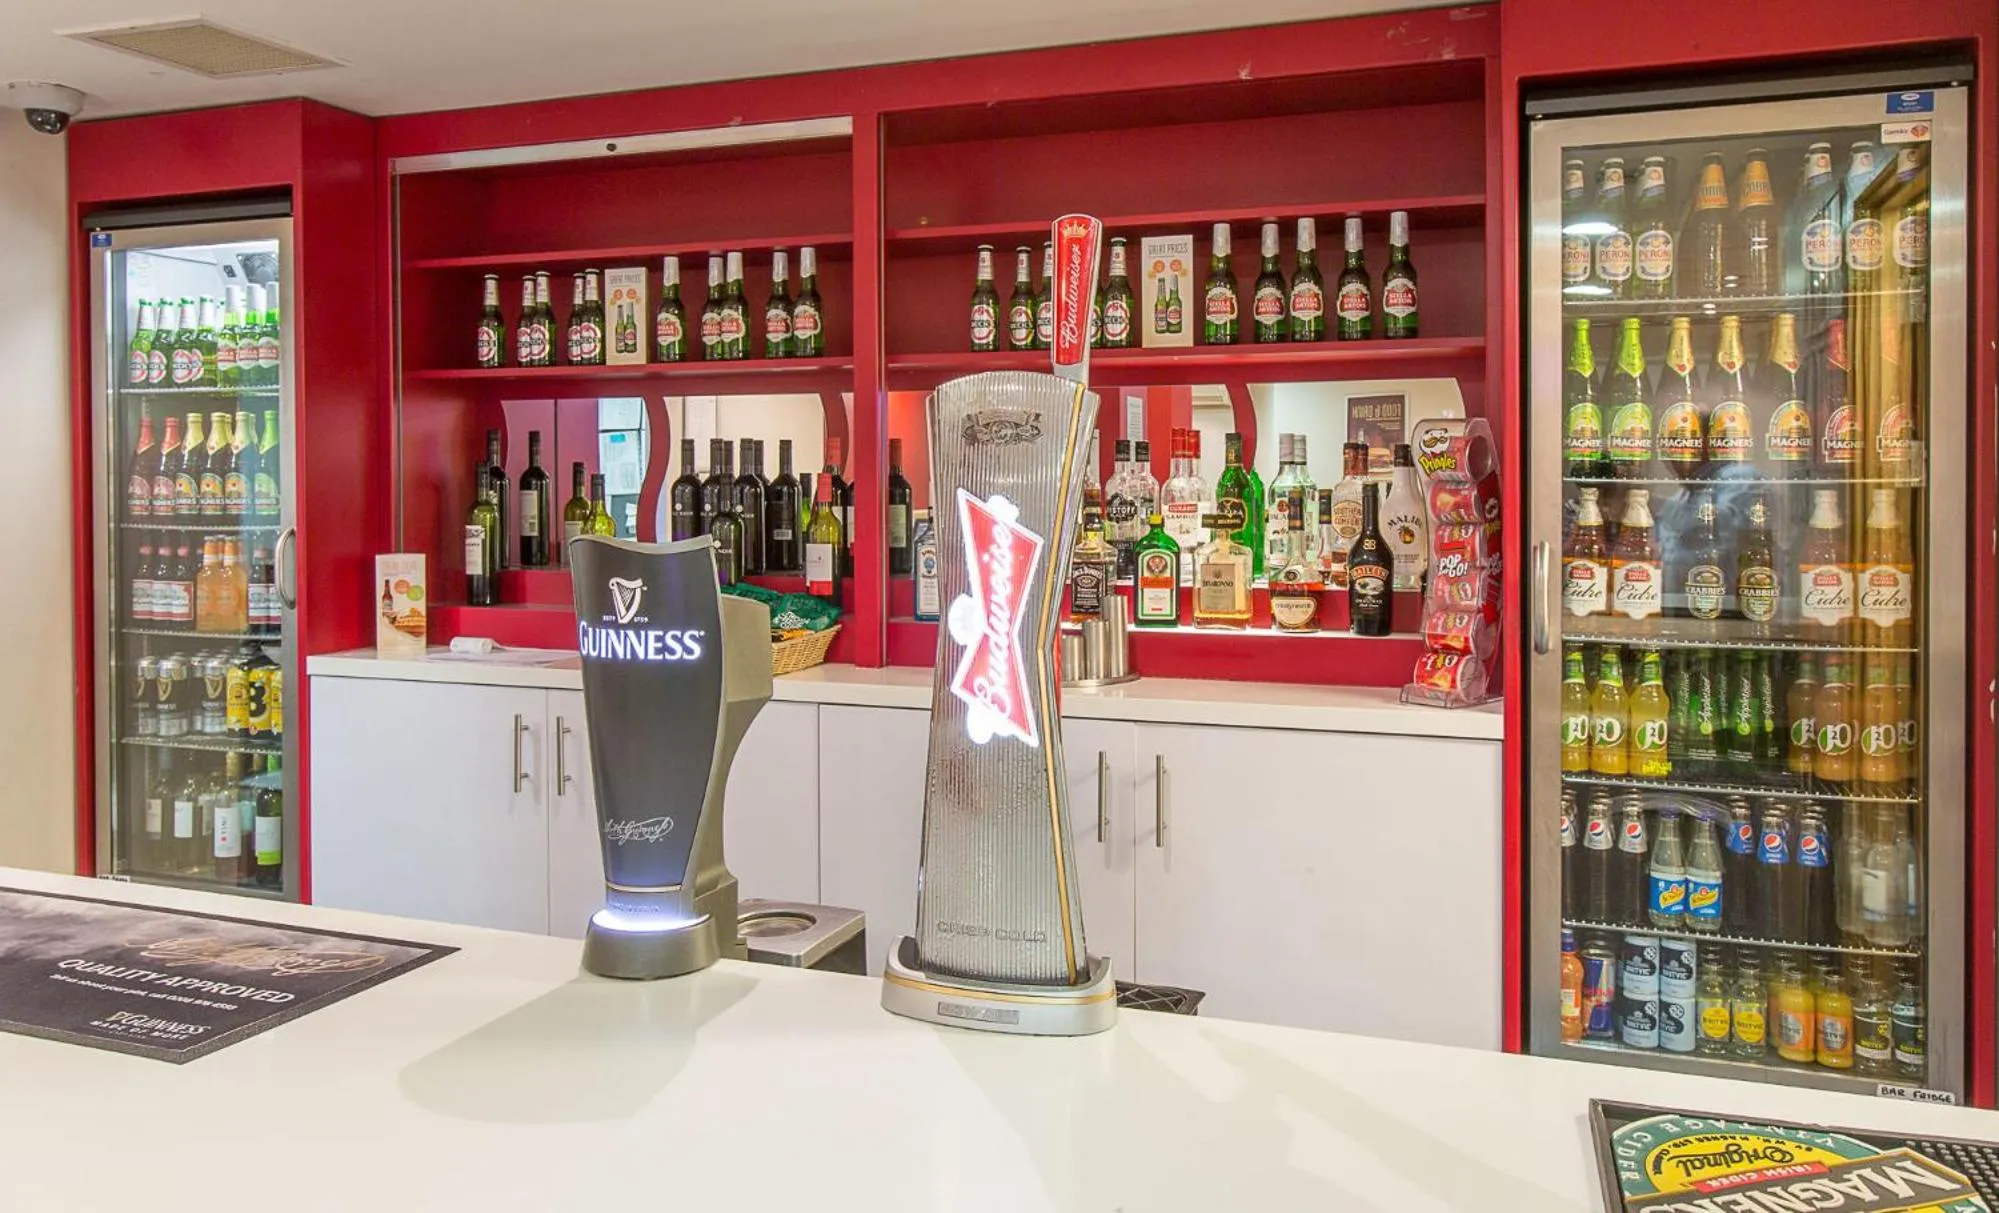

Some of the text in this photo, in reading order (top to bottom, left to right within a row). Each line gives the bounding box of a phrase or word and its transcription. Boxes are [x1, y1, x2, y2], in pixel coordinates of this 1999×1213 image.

[1060, 243, 1081, 349] Budweiser
[1709, 437, 1754, 448] MAGNERS
[1418, 453, 1457, 477] Pringles
[1350, 565, 1389, 579] BAILEYS
[1440, 554, 1461, 570] POP
[1449, 562, 1468, 577] GO!
[1563, 580, 1602, 598] Cidre
[1616, 582, 1658, 601] Cidre
[1804, 588, 1850, 607] Cidre
[1861, 588, 1908, 608] Cidre
[970, 515, 1015, 724] Budweise
[579, 620, 702, 660] GUINNESS
[59, 959, 162, 984] QUALITY
[160, 975, 296, 1004] APPROVED
[89, 1020, 127, 1032] MADE
[129, 1026, 152, 1034] OF
[151, 1031, 191, 1041] MORE
[1881, 1086, 1952, 1104] BAR FRIDGE
[1615, 1131, 1653, 1183] CIDER
[1668, 1143, 1795, 1178] Original
[1706, 1163, 1813, 1189] IRISH CIDER
